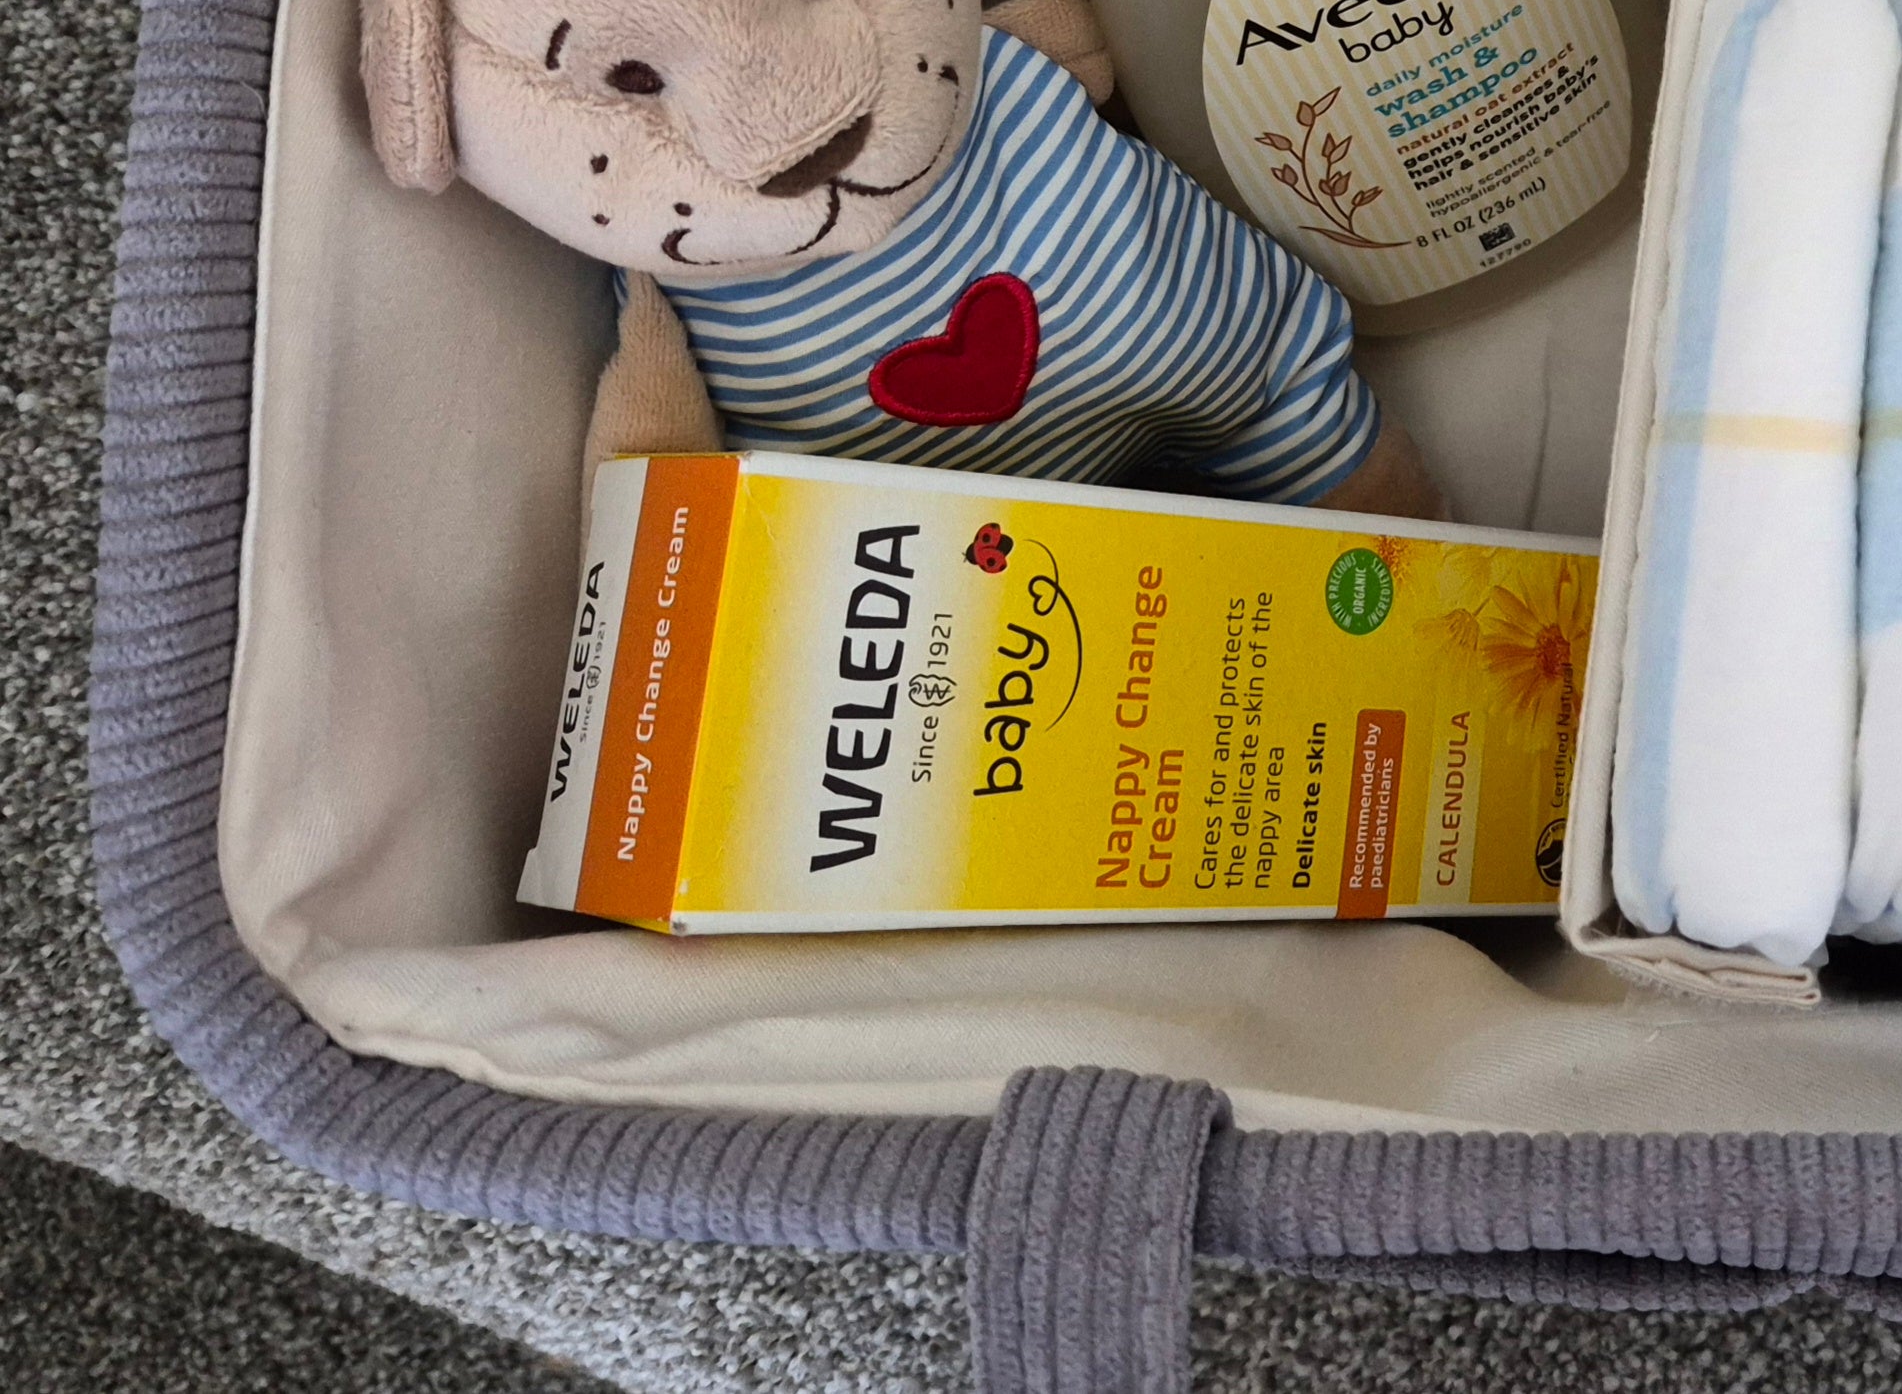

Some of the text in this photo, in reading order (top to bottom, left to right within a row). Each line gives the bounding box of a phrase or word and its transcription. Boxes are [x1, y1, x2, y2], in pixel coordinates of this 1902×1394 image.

[1338, 0, 1455, 64] baby
[1365, 3, 1524, 98] daily moisture
[1374, 45, 1500, 118] wash &
[1387, 46, 1539, 139] shampoo
[1396, 41, 1575, 156] natural oat extract
[1403, 64, 1571, 171] gently cleanses &
[1407, 53, 1600, 181] helps nourish baby's
[1413, 71, 1598, 192] hair & sensitive skin
[1429, 99, 1612, 219] hypoallergenic & tear-free
[1415, 175, 1548, 249] 8 FL OZ (236 mL)
[1425, 145, 1537, 211] lightly scented
[1327, 551, 1358, 601] PRECIOUS
[1331, 601, 1353, 629] WITH
[1352, 566, 1368, 615] ORGANIC
[1367, 556, 1392, 628] INGREDIENTS
[550, 561, 606, 803] WELEDA
[579, 620, 607, 744] Since 1921
[616, 506, 689, 861] Nappy Change Cream
[809, 524, 921, 874] WELEDA
[911, 612, 954, 783] Since 1921
[972, 622, 1051, 798] baby
[1095, 564, 1169, 889] Nappy Change
[1223, 590, 1274, 890] the delicate skin of the
[1555, 662, 1575, 729] Natural
[1194, 596, 1247, 891] Cares for and protects
[1435, 709, 1472, 887] CALENDULA
[1550, 731, 1571, 809] Certified
[1138, 748, 1186, 890] Cream
[1254, 745, 1286, 890] nappy area
[1292, 721, 1328, 890] Delicate skin
[1349, 722, 1382, 890] Recommended by
[1370, 757, 1395, 889] paediatricians
